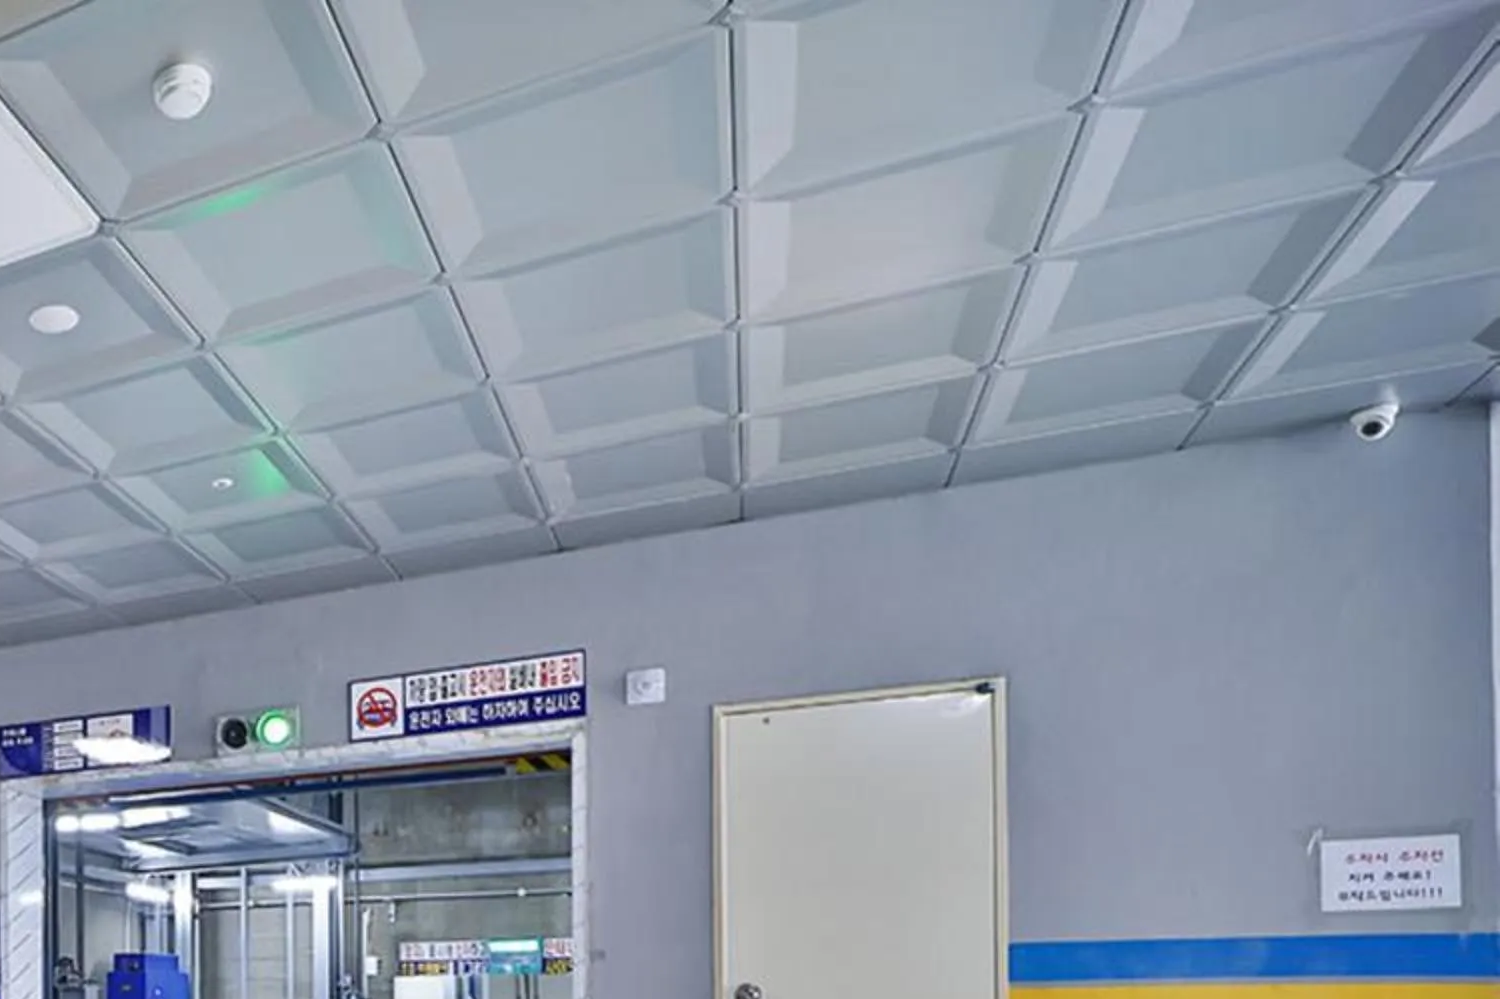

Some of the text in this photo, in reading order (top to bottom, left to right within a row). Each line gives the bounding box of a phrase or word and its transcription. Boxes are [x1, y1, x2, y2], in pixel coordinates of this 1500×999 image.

[408, 708, 443, 731] 운전자
[532, 691, 582, 716] 주십시오
[1346, 849, 1444, 865] 주차시 주차선
